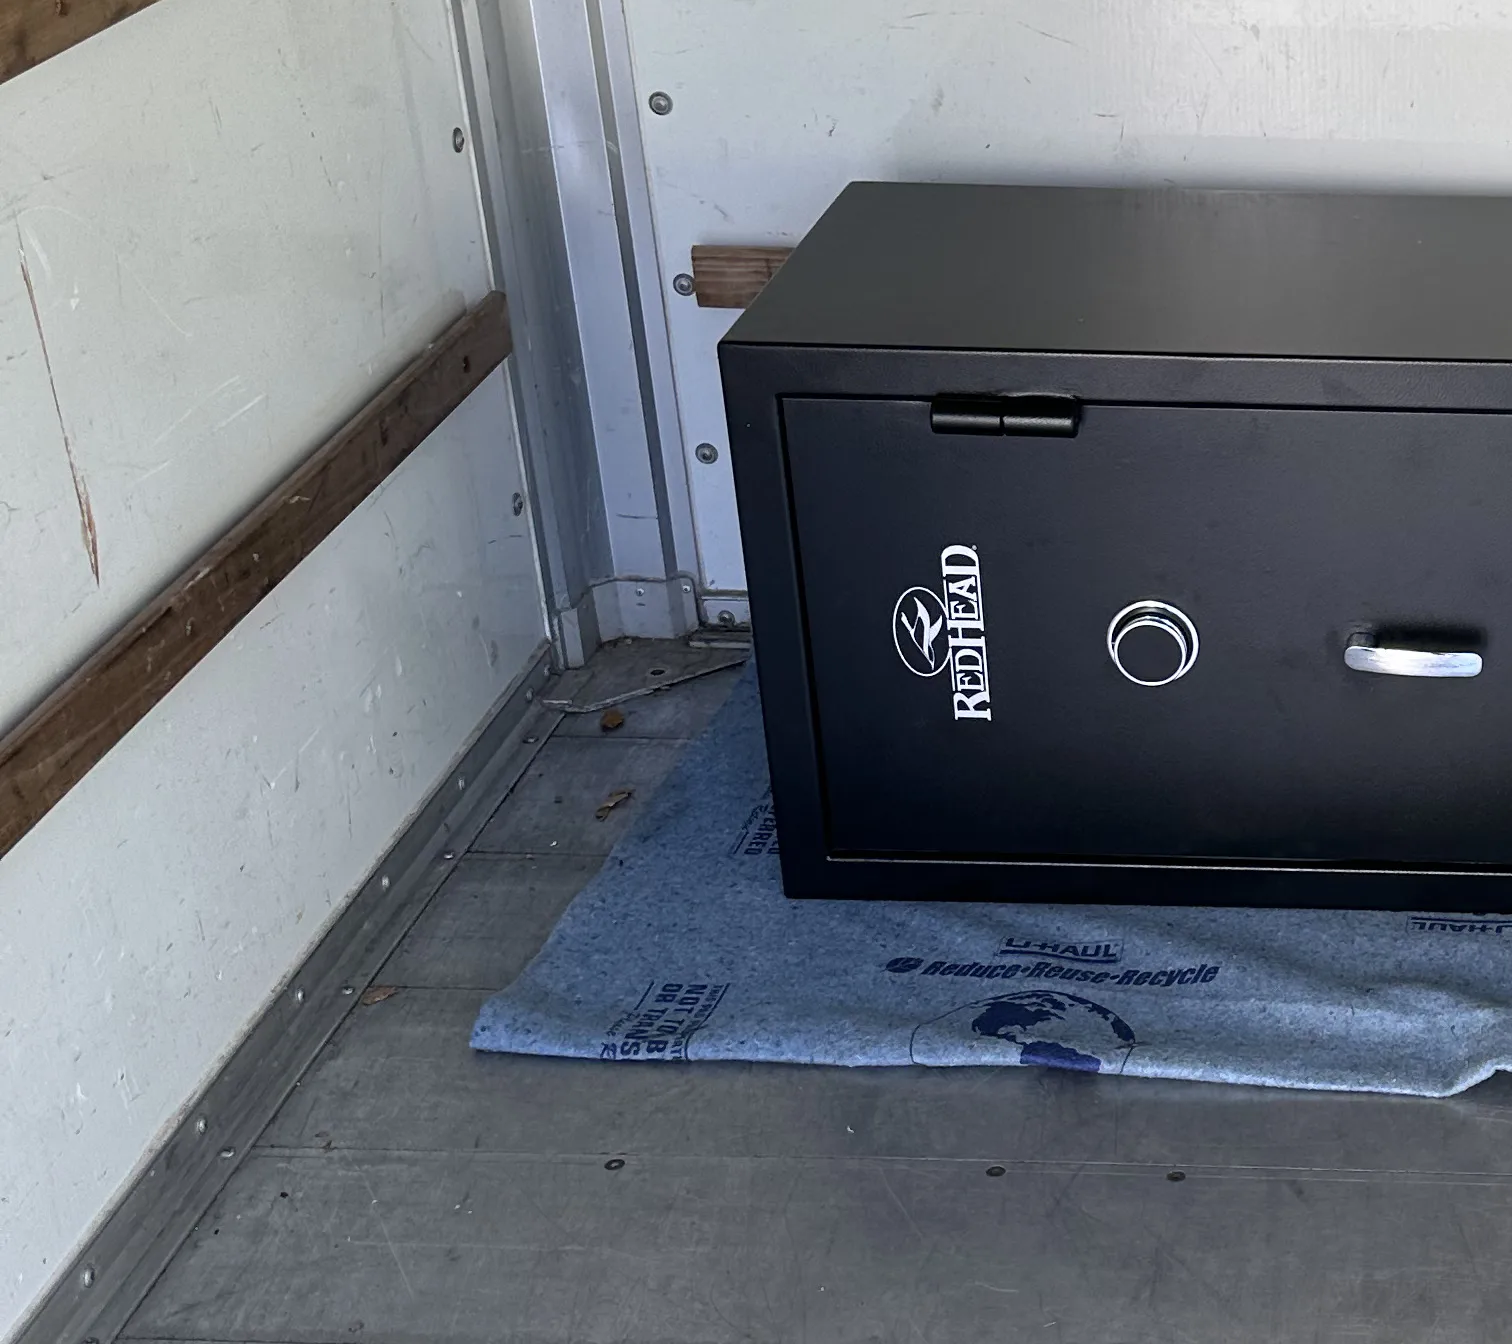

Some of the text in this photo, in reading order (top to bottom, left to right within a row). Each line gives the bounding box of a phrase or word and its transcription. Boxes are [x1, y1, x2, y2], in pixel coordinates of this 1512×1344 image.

[940, 544, 992, 722] REDHEAD
[1005, 937, 1118, 958] U-HAUL
[655, 983, 684, 1002] OR
[673, 984, 708, 1014] NOT
